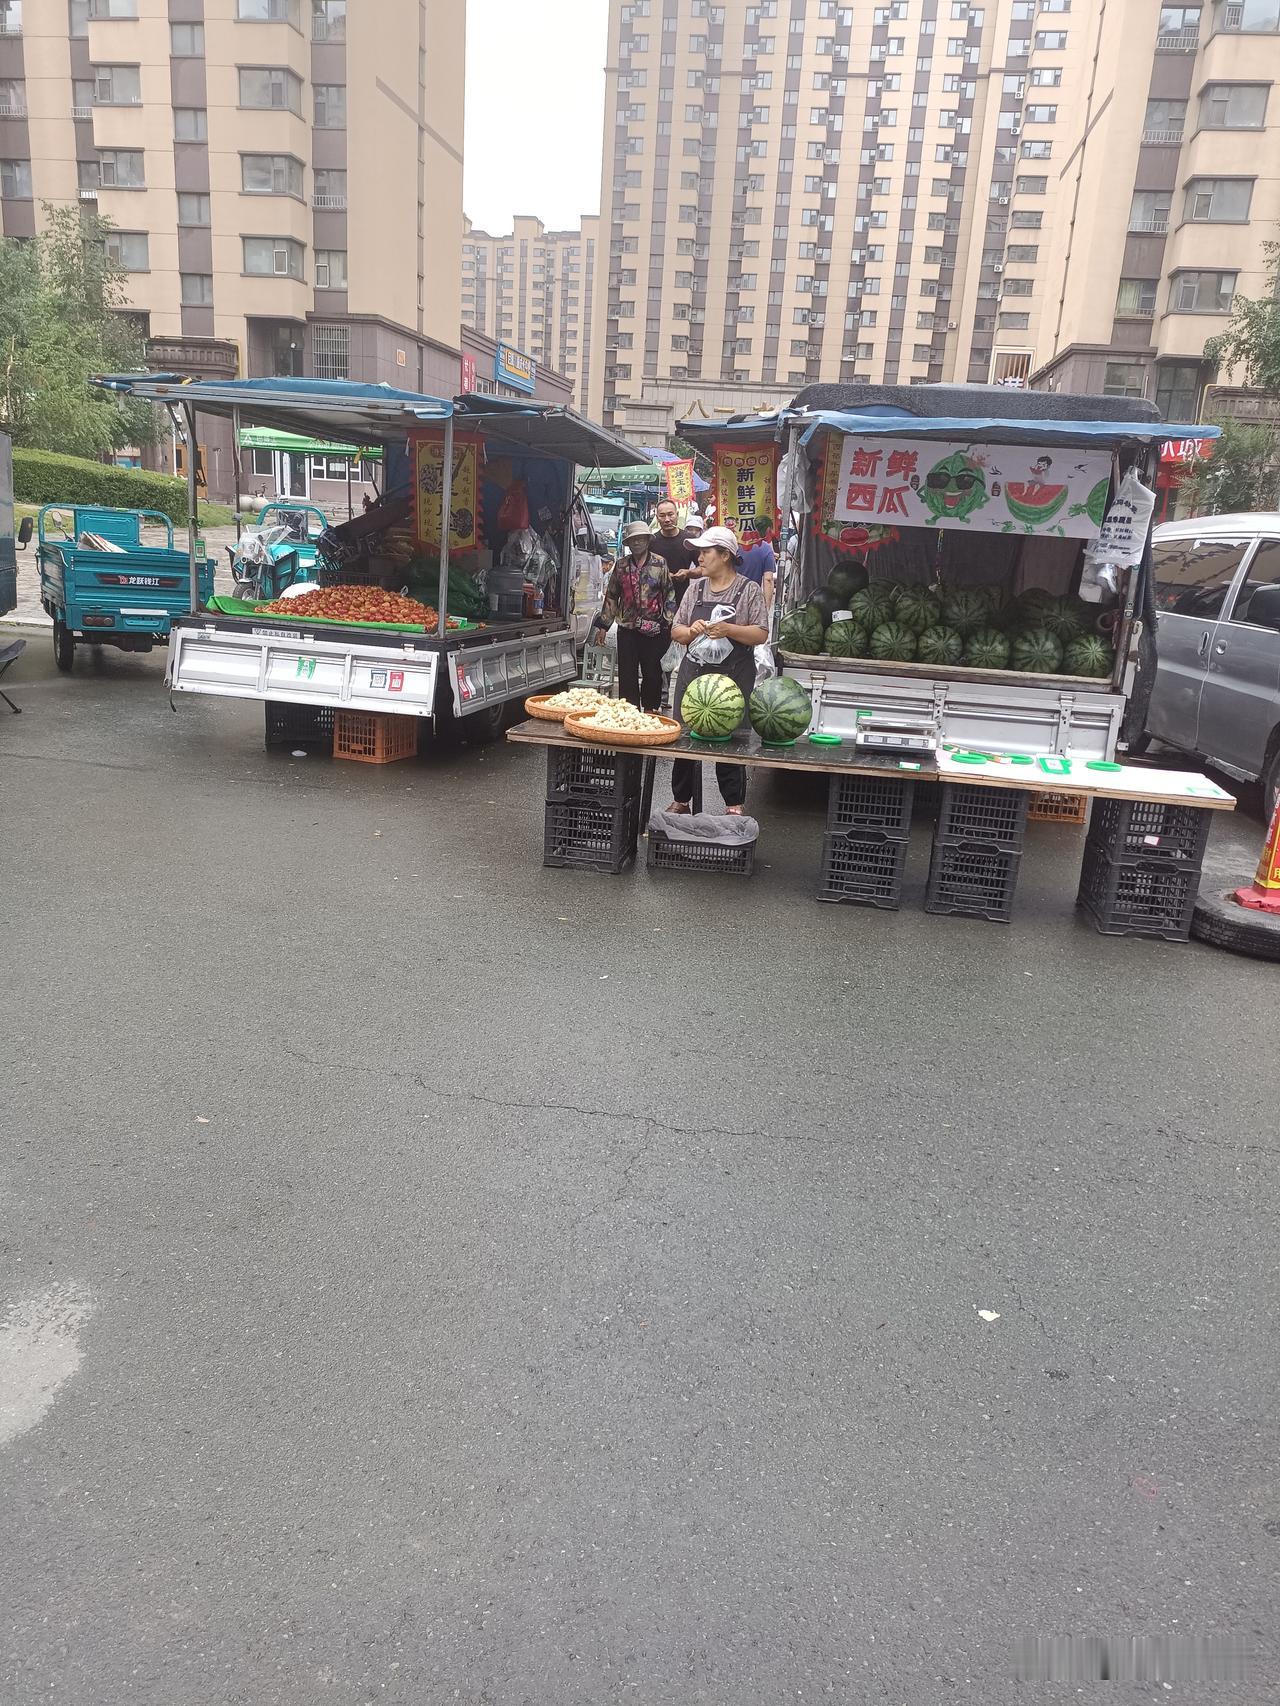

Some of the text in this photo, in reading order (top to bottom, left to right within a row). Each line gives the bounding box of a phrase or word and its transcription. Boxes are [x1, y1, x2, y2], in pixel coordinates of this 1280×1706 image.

[675, 470, 687, 494] 烤玉米
[850, 446, 920, 482] 新鲜
[736, 467, 756, 532] 新鲜西瓜
[845, 482, 910, 518] 西瓜
[128, 576, 160, 586] 龙跃钱江
